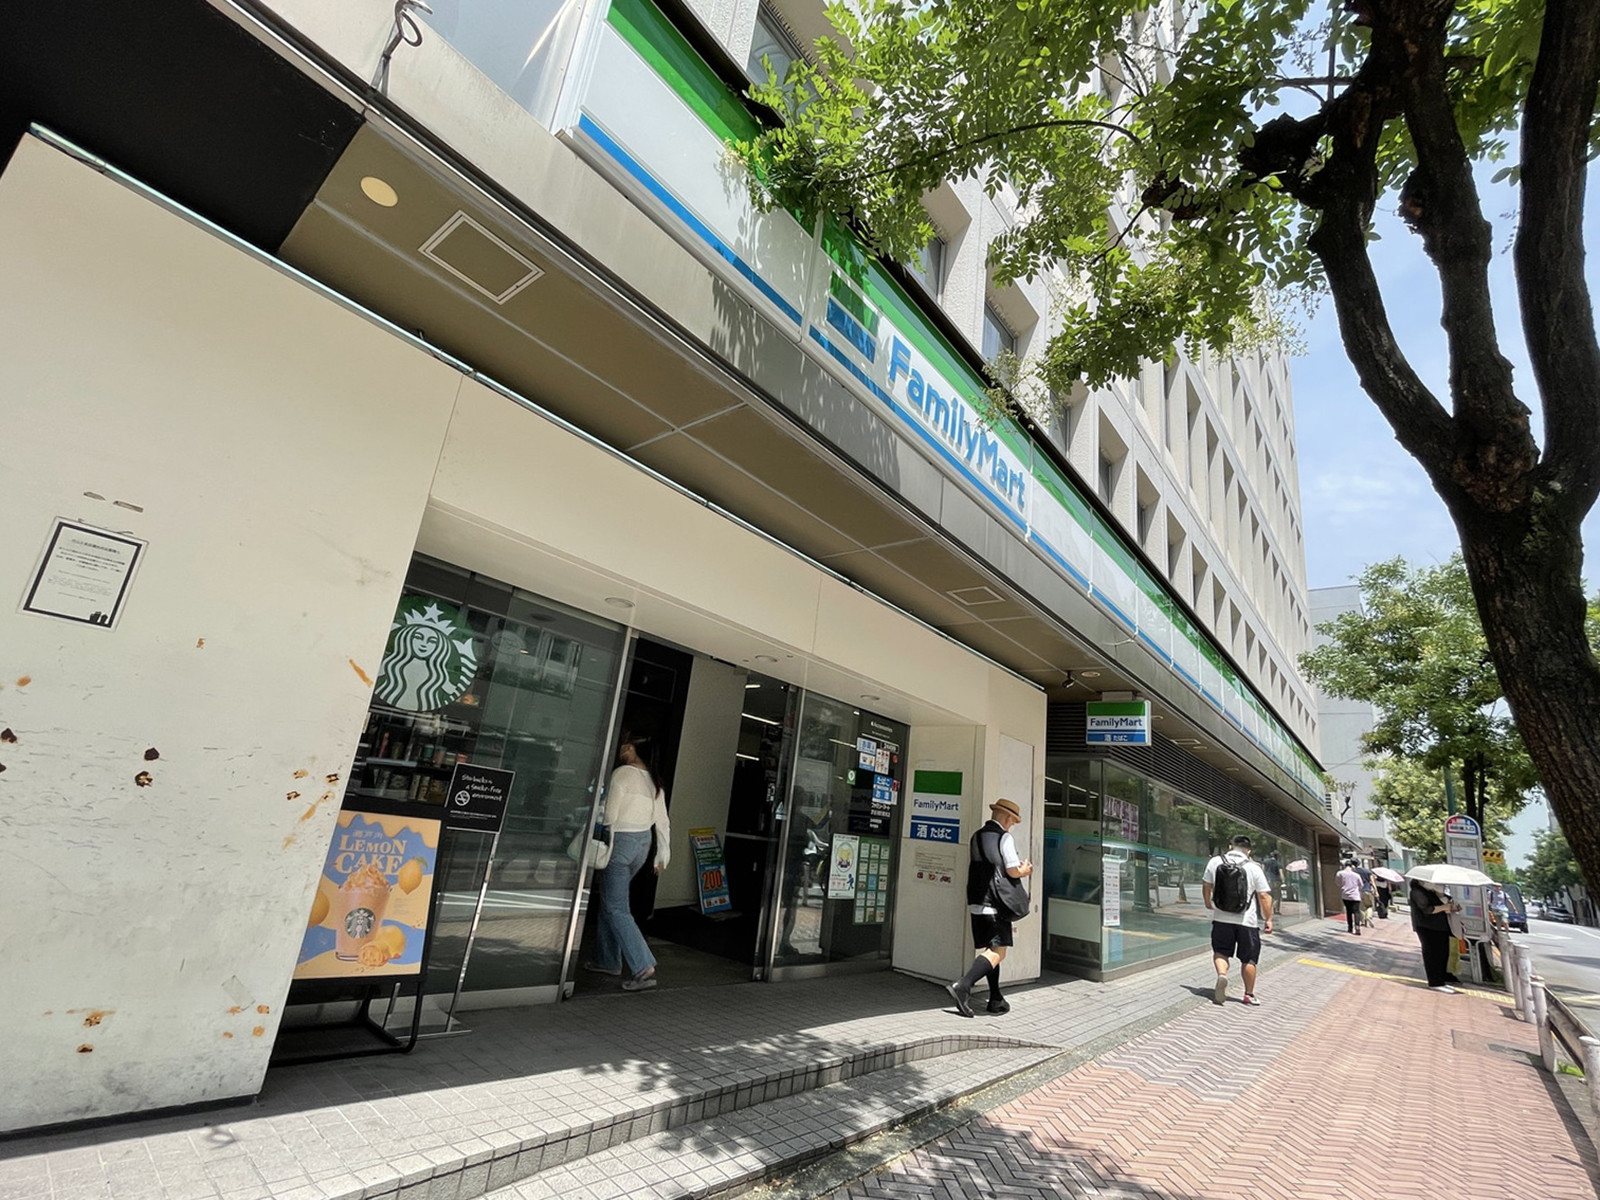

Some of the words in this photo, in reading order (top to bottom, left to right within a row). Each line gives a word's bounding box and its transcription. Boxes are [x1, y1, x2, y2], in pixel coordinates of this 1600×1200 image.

[888, 334, 1025, 508] FamilyMart
[1091, 718, 1142, 728] FamilyMart
[913, 799, 959, 811] FamilyMart
[917, 824, 928, 838] 酒
[930, 827, 952, 840] たばこ
[339, 834, 408, 854] LEMON
[335, 851, 403, 875] CAKE
[702, 870, 723, 890] 200
